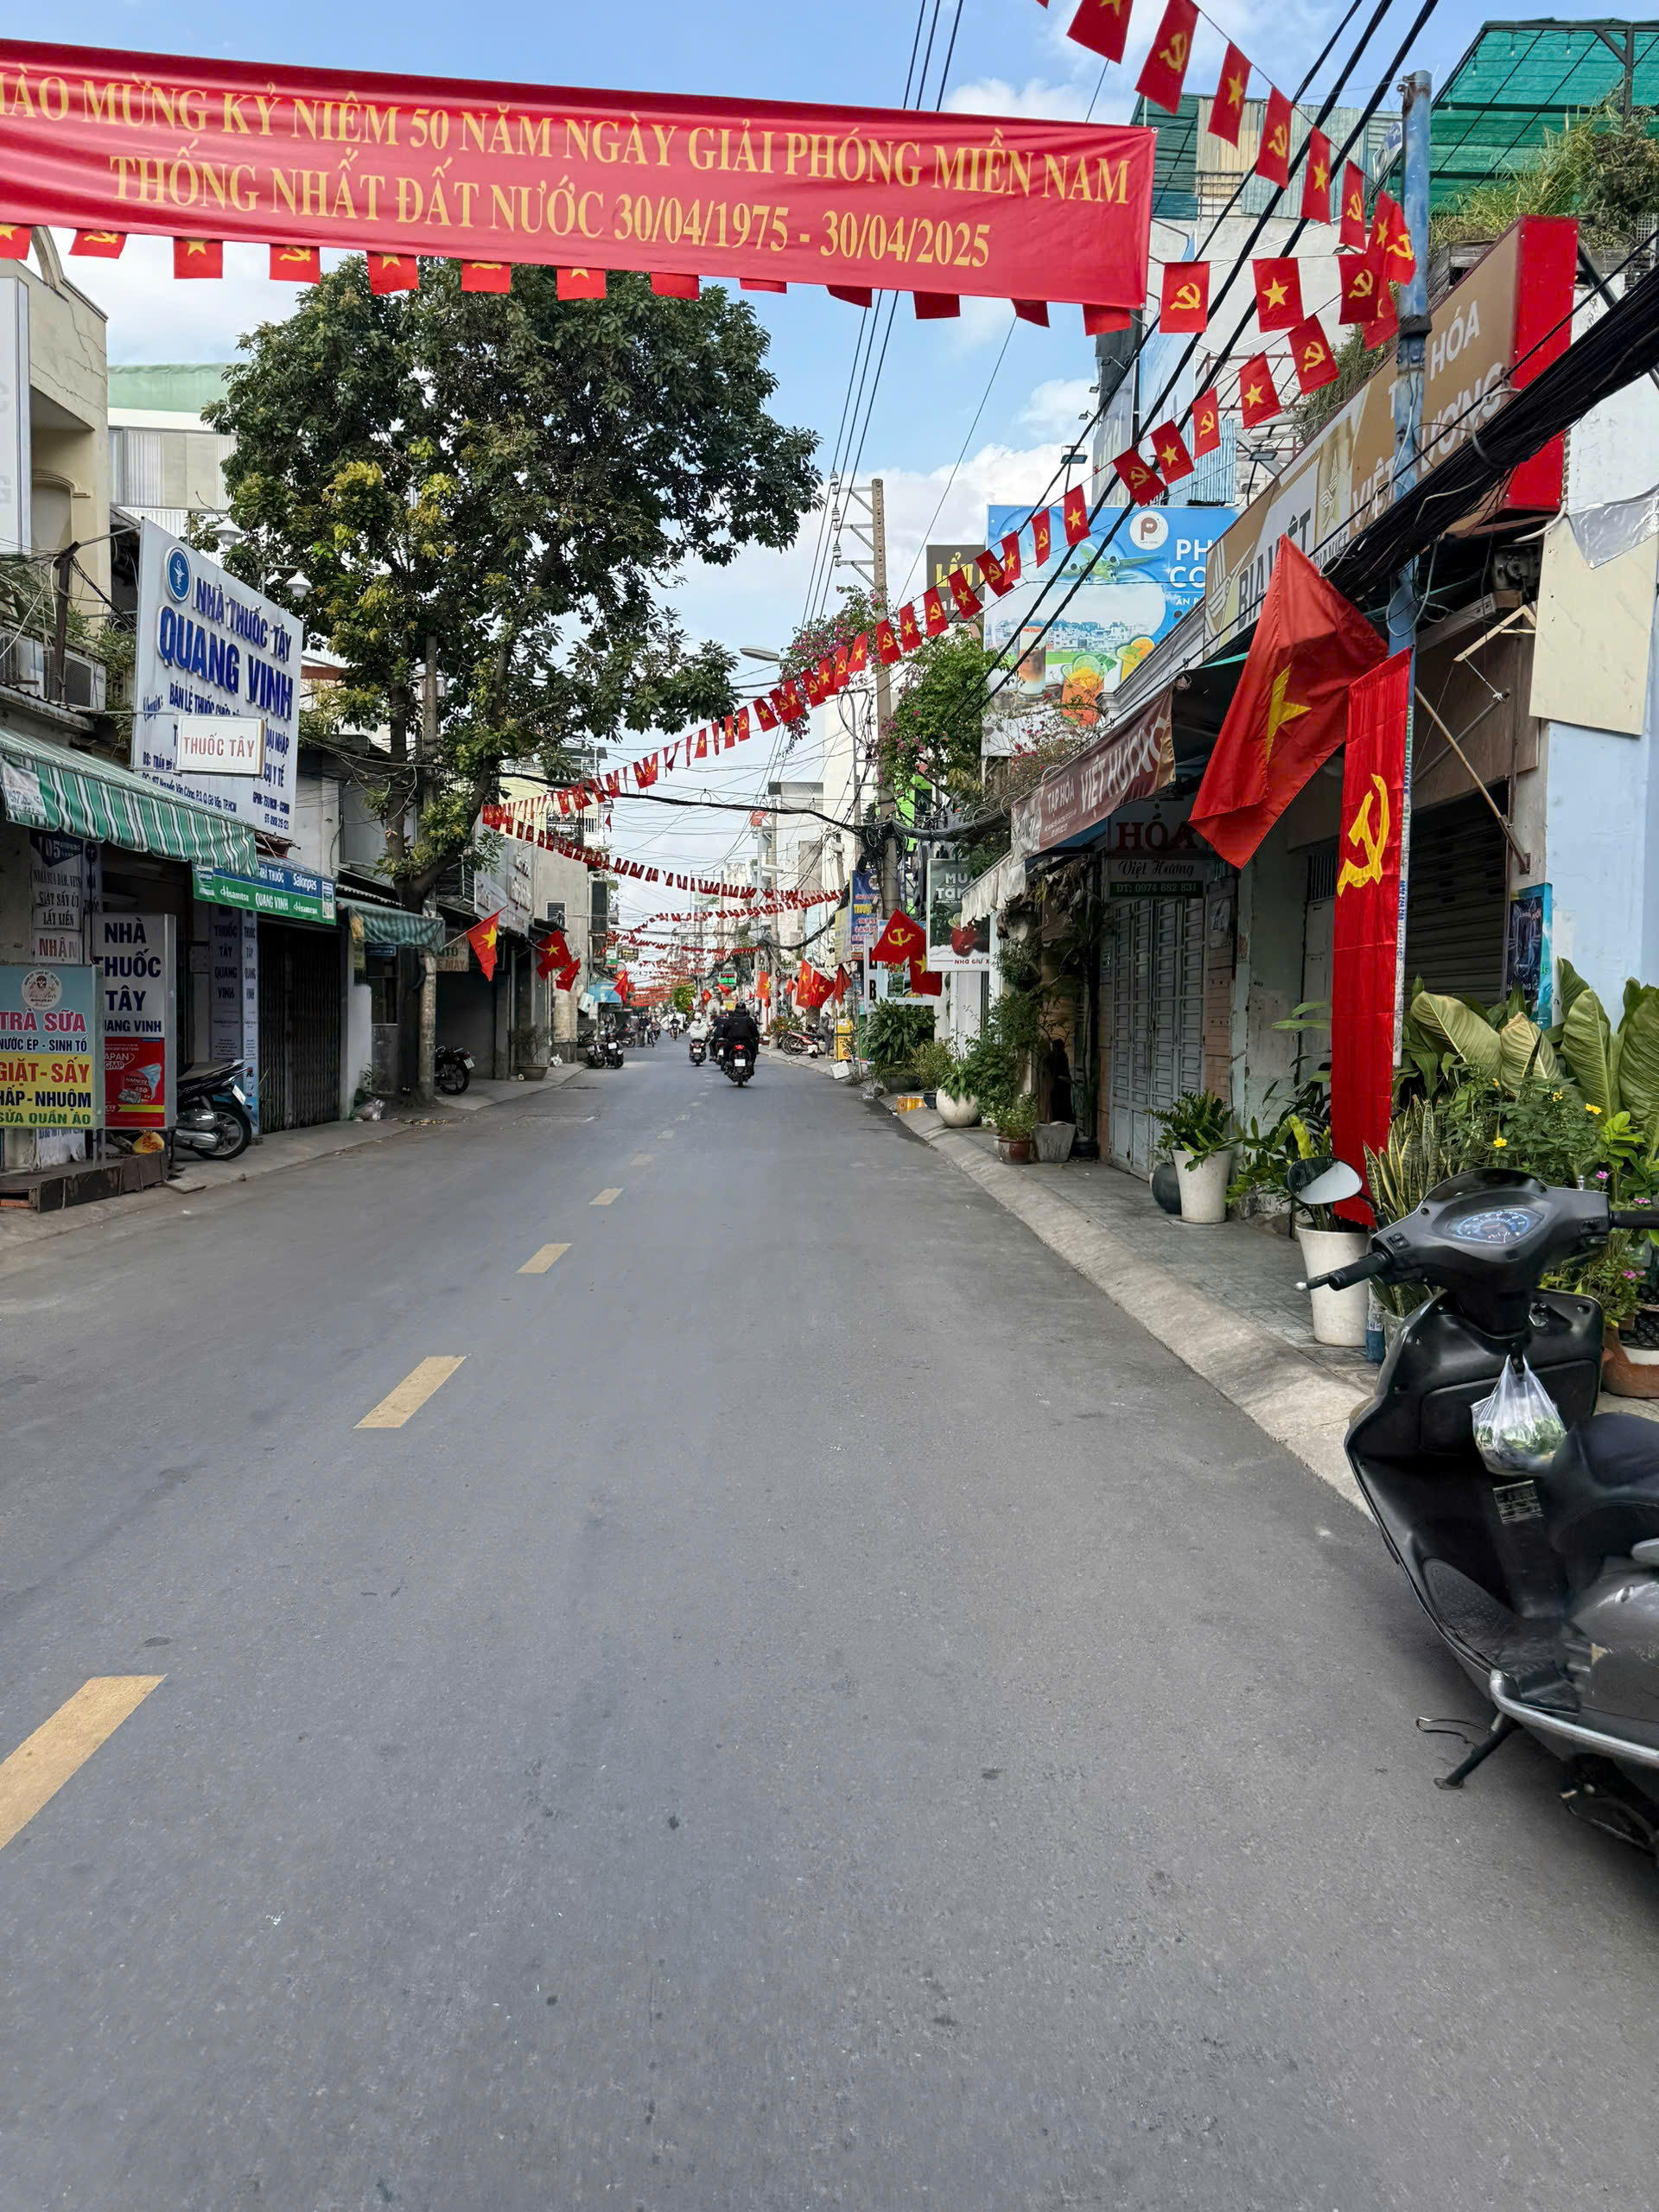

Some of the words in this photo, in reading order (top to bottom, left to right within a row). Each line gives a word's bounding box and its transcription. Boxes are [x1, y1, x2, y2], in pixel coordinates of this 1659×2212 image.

[82, 73, 208, 131] MỪNG
[221, 81, 281, 136] KỶ
[410, 109, 449, 150] 50
[460, 103, 553, 158] NĂM
[563, 111, 678, 167] NGÀY
[688, 118, 775, 174] GIẢI
[784, 127, 923, 188] PHÓNG
[931, 127, 1034, 197] MIỀN
[1040, 153, 1131, 204] NAM
[109, 138, 260, 213] THỐNG
[270, 149, 385, 220] NHẤT
[395, 156, 480, 227] ĐẤT
[490, 175, 604, 238] NƯỚC
[614, 194, 790, 251] 30/04/1975
[798, 232, 810, 243] -
[820, 210, 991, 268] 30/04/2025
[1430, 300, 1480, 381] HÓA
[194, 576, 225, 625] NHÀ
[226, 605, 269, 649] THUỐC
[271, 622, 292, 663] TÂY
[158, 605, 240, 694] QUANG
[246, 654, 294, 721] VINH
[183, 733, 225, 756] THUỐC
[229, 736, 256, 758] TÂY
[1116, 812, 1198, 851] HÓA
[1117, 860, 1147, 879] Việt
[105, 918, 147, 944] NHÀ
[39, 937, 77, 962] NHẬN
[214, 965, 238, 979] QUANG
[105, 985, 147, 1012] TÂY
[0, 1008, 38, 1032] TRÀ
[44, 1009, 86, 1033] SỮA
[134, 1020, 162, 1033] VINH
[27, 1036, 39, 1052] ÉP
[49, 1039, 72, 1052] SINH
[75, 1036, 87, 1053] TỐ
[72, 1111, 91, 1125] ÁO
